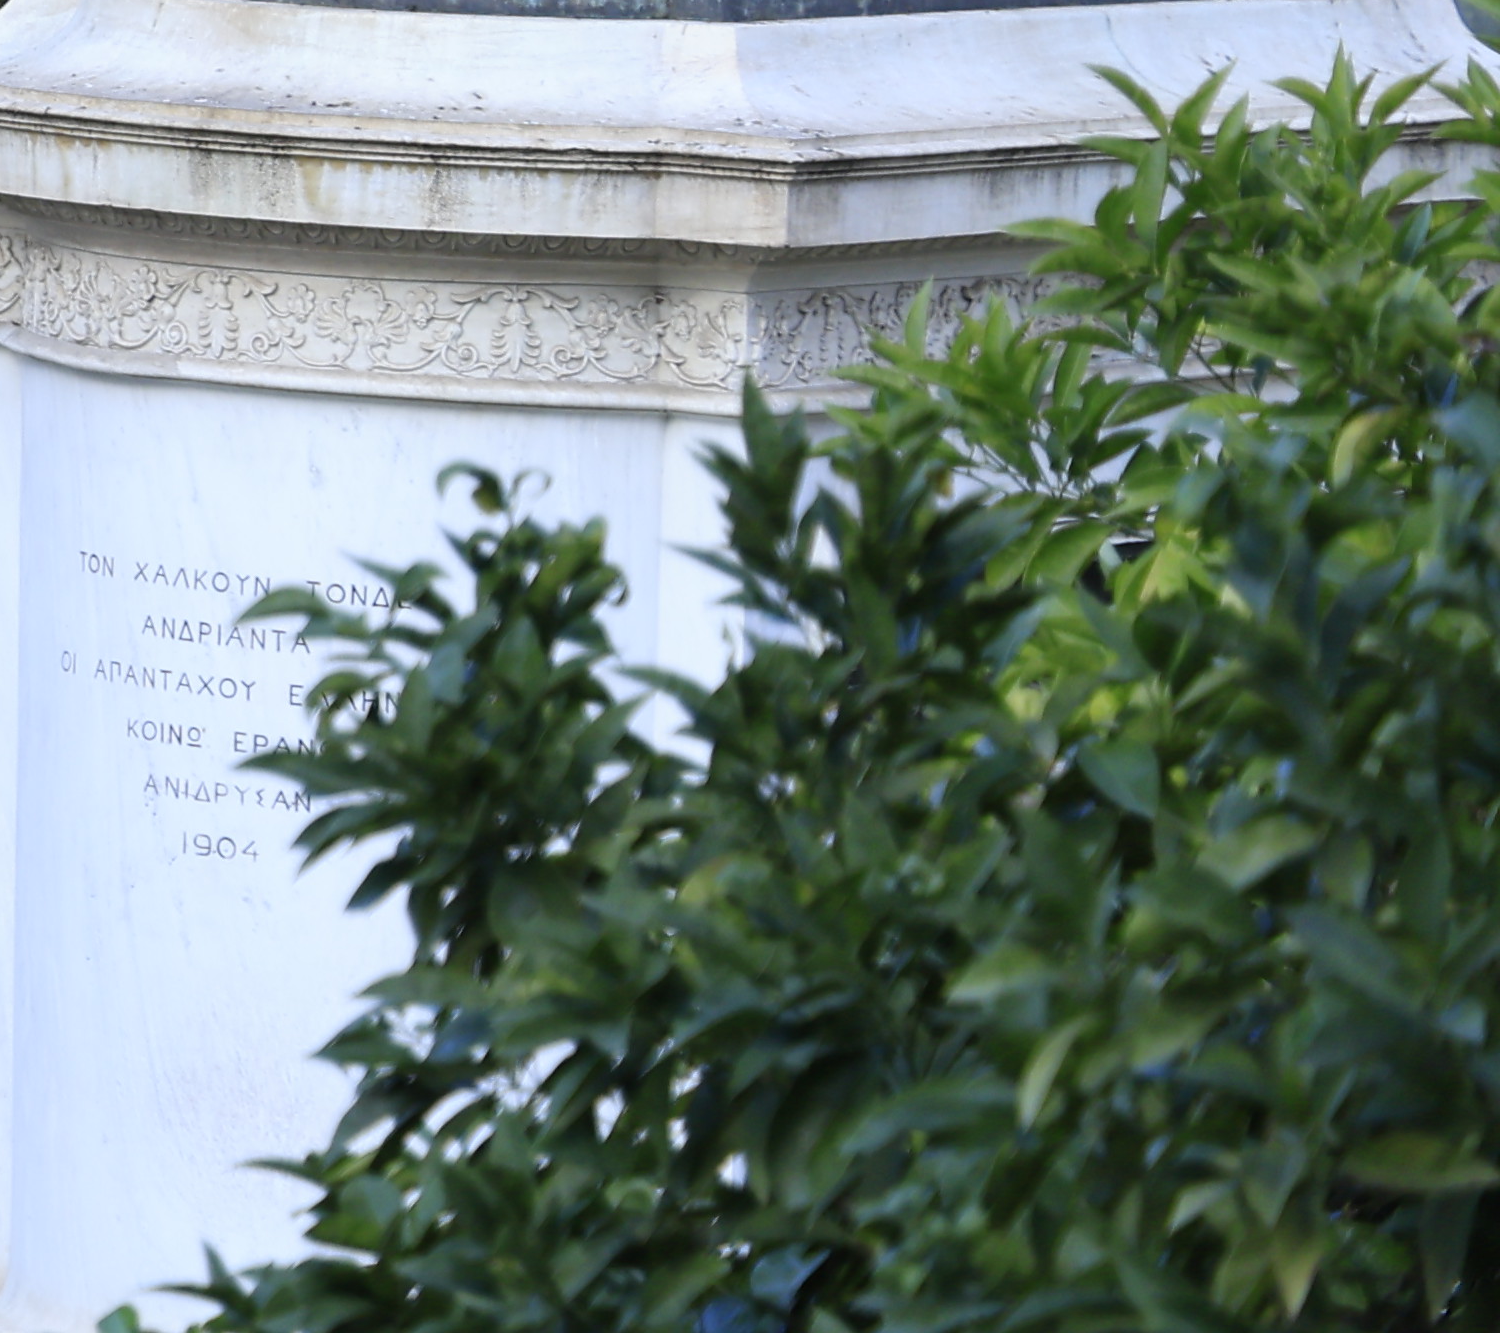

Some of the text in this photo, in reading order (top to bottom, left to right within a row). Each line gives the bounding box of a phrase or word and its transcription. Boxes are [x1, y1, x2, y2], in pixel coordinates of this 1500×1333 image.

[80, 550, 115, 578] ΤΟΝ
[134, 561, 271, 597] ΧΑΛΚΟΥΝ
[142, 615, 311, 655] ΑΝΔΡΙΑΝΤΑ
[61, 650, 77, 675] ΟΙ
[94, 659, 256, 702] ΑΠΑΝΤΑΧΟΥ
[143, 774, 312, 813] ΑΝΙΔΡΥΣΑΝ
[182, 831, 260, 863] 1904
